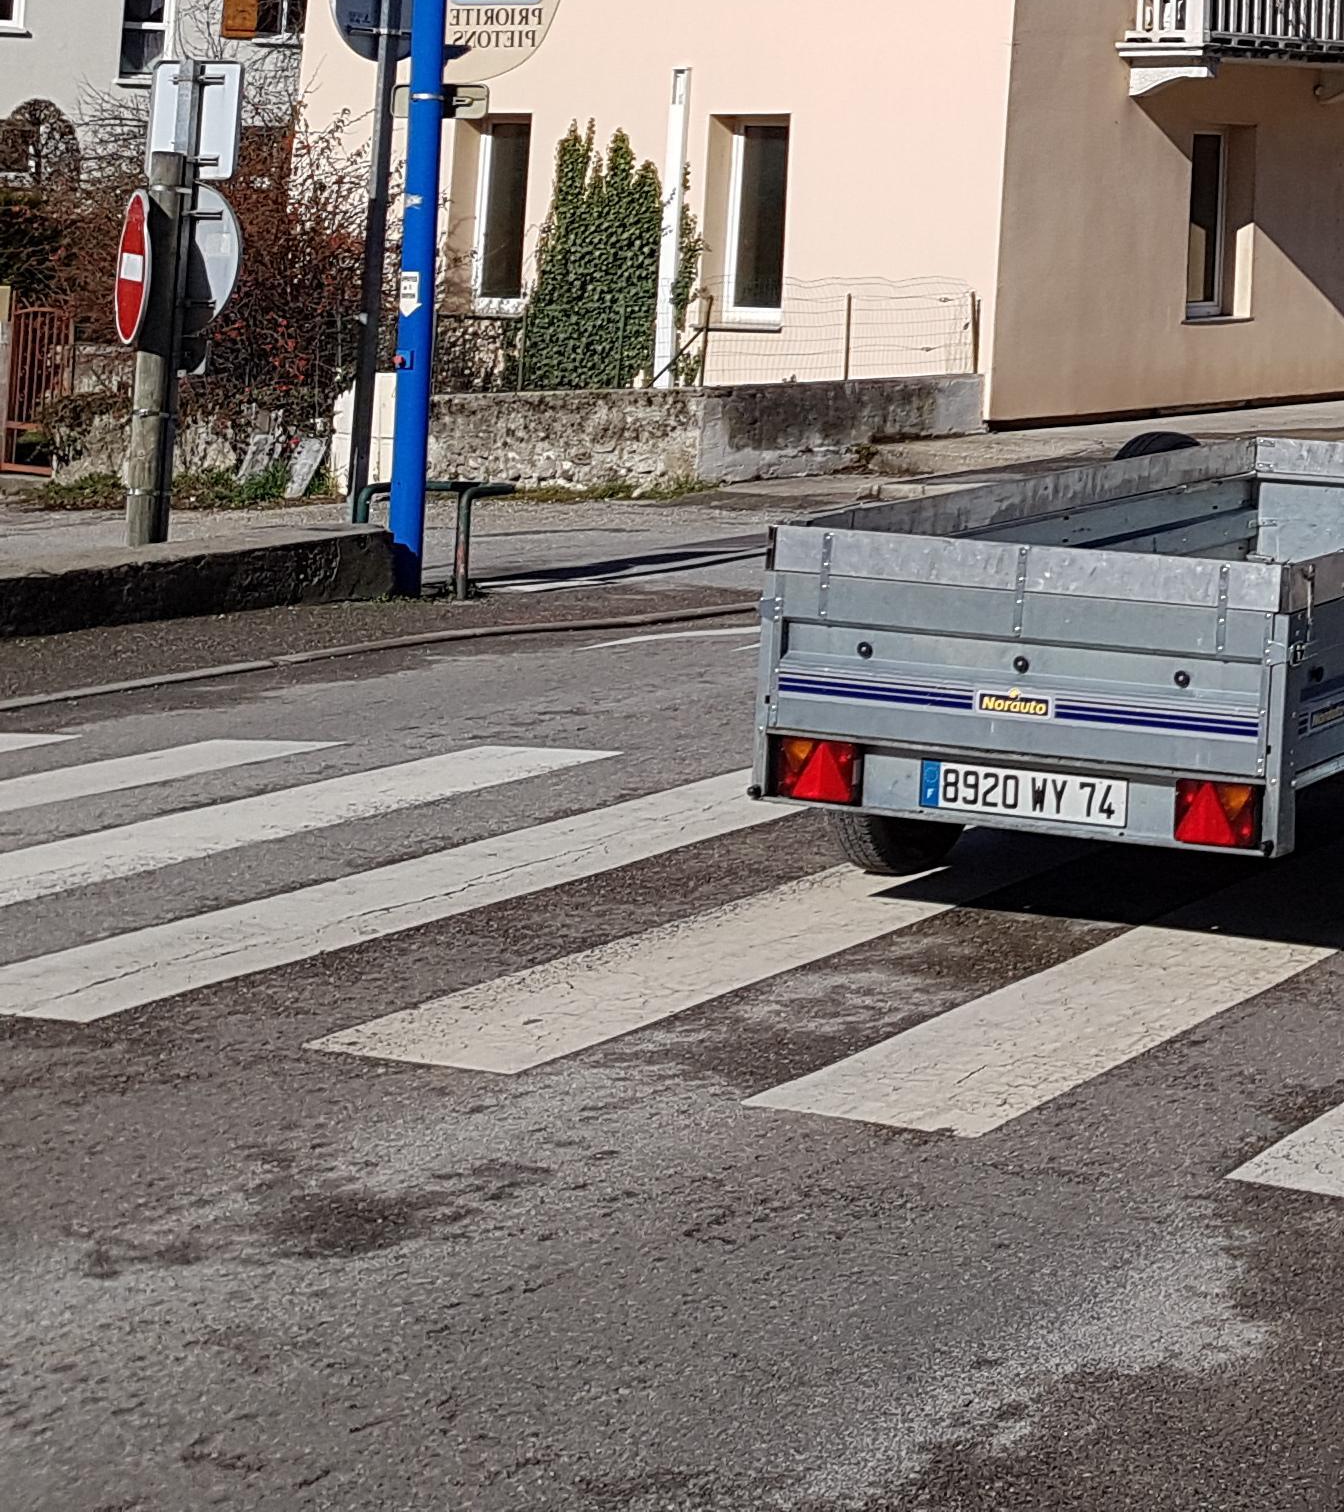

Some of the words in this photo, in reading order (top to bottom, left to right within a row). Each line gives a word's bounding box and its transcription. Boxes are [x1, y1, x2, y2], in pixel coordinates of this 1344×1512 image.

[981, 695, 1047, 715] Norauto
[942, 768, 1019, 810] 8920
[1031, 776, 1067, 814] WY
[1079, 781, 1115, 819] 74
